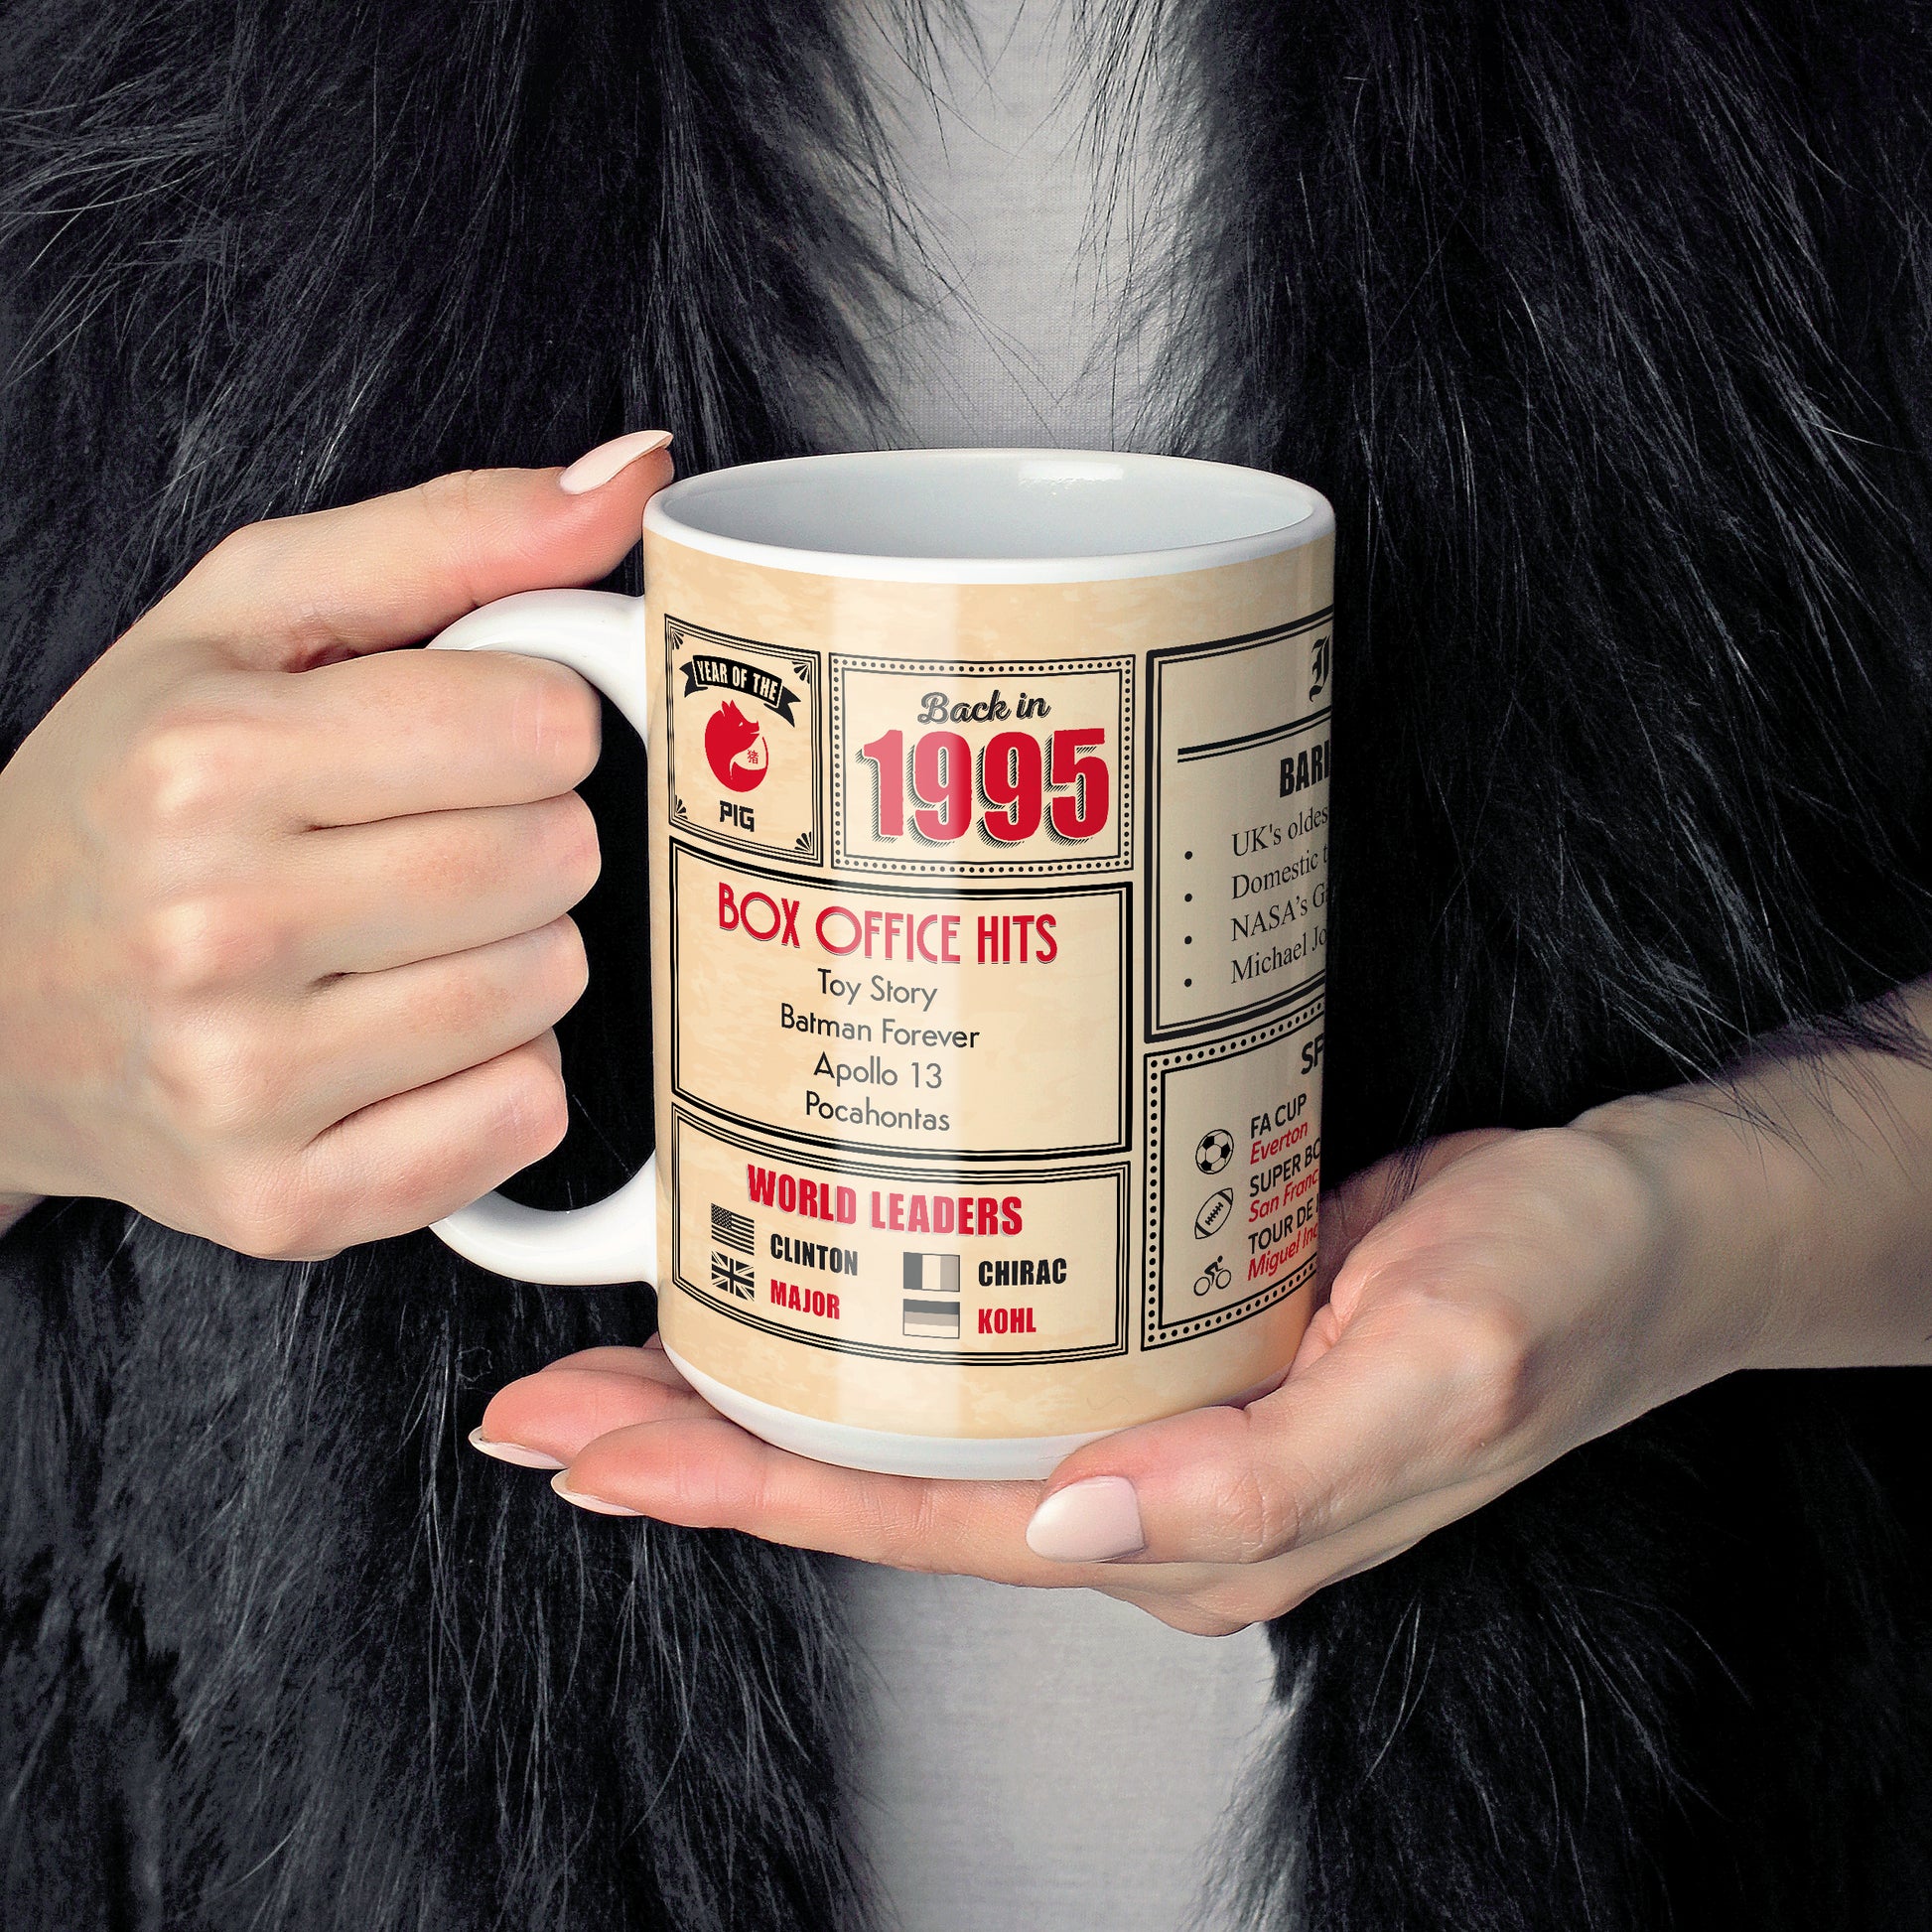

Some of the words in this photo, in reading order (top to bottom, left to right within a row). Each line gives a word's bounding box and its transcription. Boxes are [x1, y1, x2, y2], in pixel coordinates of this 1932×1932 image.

[696, 658, 730, 685] YEAR
[732, 666, 749, 687] OF
[752, 673, 779, 703] THE
[916, 689, 1011, 724] Back
[1015, 692, 1052, 719] in
[747, 749, 759, 764] 猪
[855, 727, 1110, 850] 1995
[719, 799, 756, 833] PIG
[1231, 822, 1283, 857] UK's
[1287, 805, 1328, 840] oldes
[1231, 849, 1318, 899] Domestic
[718, 882, 801, 948] BOX
[815, 905, 961, 964] OFFICE
[977, 913, 1058, 965] HITS
[1231, 932, 1307, 984] Michael
[817, 968, 862, 1006] Toy
[870, 974, 938, 1012] Story
[780, 1003, 873, 1042] Batman
[882, 1018, 981, 1048] Forever
[813, 1050, 898, 1087] Apollo
[910, 1061, 943, 1089] 13
[805, 1090, 951, 1132] Pocahontas
[1250, 1115, 1272, 1140] FA
[1275, 1093, 1308, 1128] CUP
[1250, 1122, 1309, 1165] Everton
[1249, 1153, 1302, 1198] SUPER
[747, 1164, 857, 1225] WORLD
[870, 1191, 1023, 1236] LEADERS
[1248, 1195, 1280, 1223] San
[1247, 1214, 1294, 1255] TOUR
[1297, 1197, 1314, 1229] DE
[769, 1233, 859, 1276] CLINTON
[978, 1258, 1067, 1287] CHIRAC
[1247, 1230, 1302, 1281] Miguel
[769, 1279, 840, 1319] MAJOR
[978, 1308, 1037, 1334] KOHL
